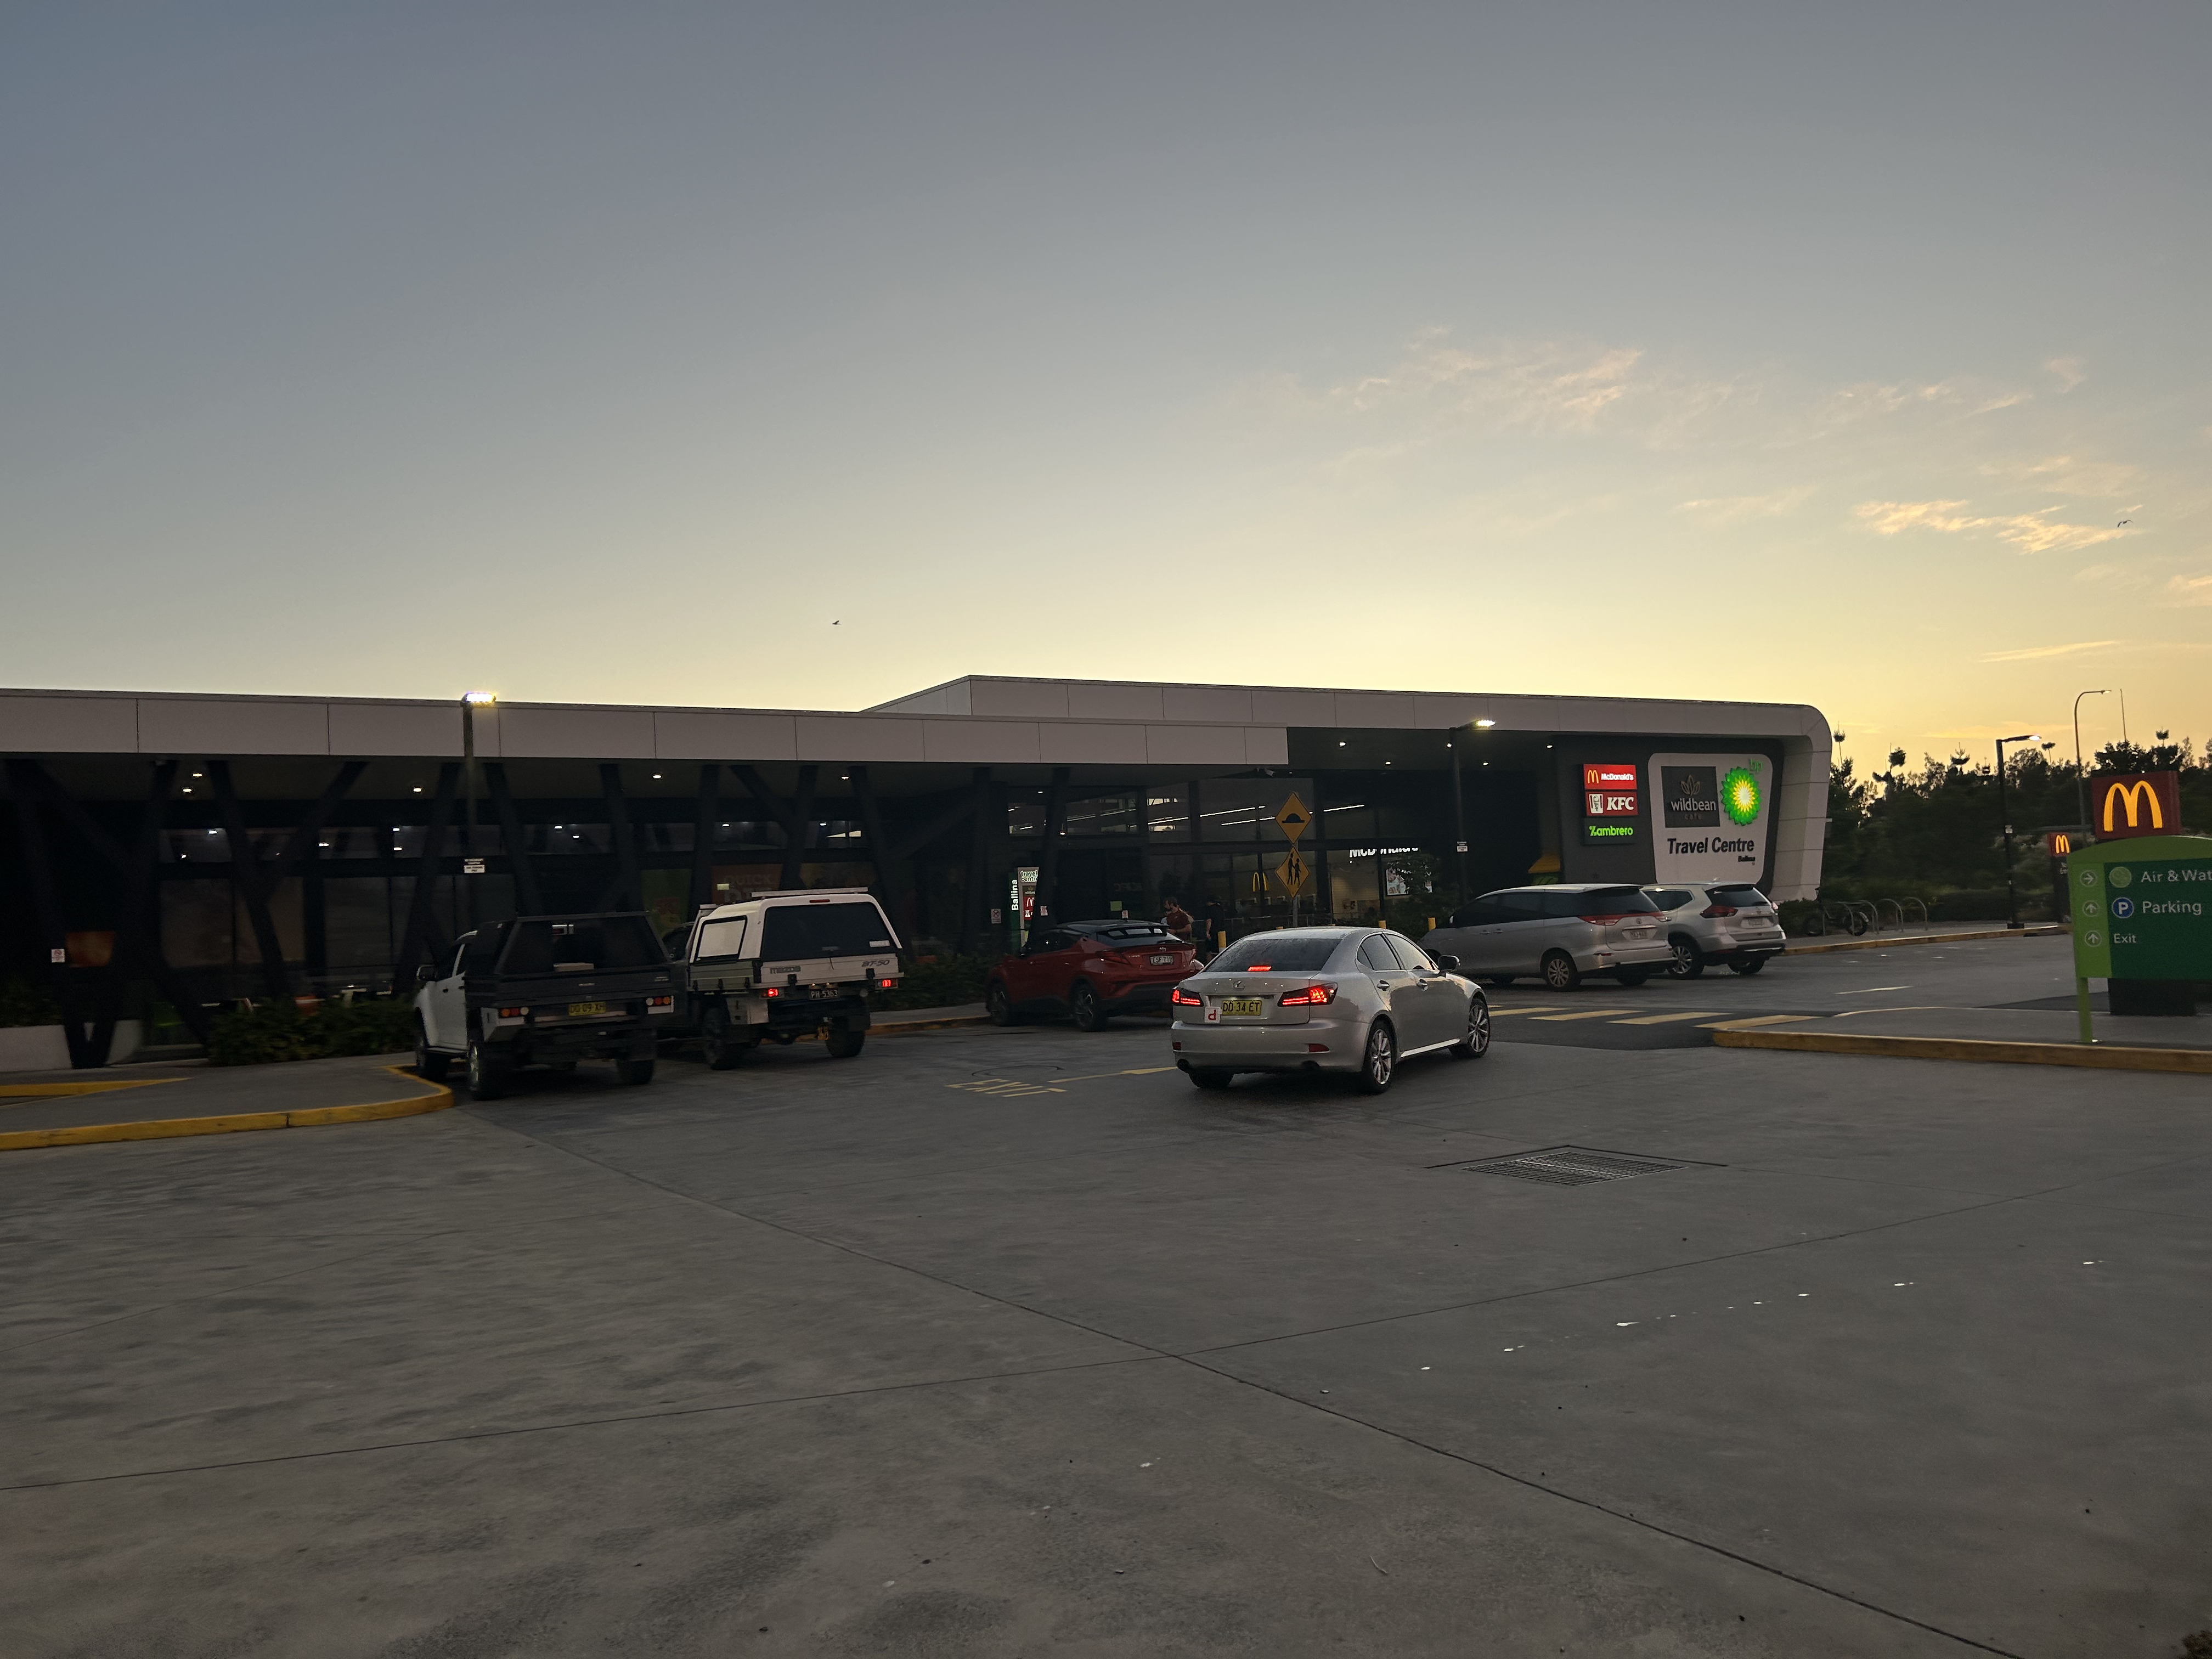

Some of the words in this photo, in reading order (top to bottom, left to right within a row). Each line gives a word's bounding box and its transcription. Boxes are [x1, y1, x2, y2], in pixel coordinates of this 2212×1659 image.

[1606, 797, 1634, 810] KFC
[1671, 798, 1717, 811] wildbean
[1589, 825, 1634, 837] Zambrero
[1667, 837, 1708, 854] Travel
[1712, 837, 1754, 853] Centre
[2141, 871, 2163, 883] Air
[2168, 870, 2180, 882] &
[1011, 879, 1019, 911] Ballina
[2142, 900, 2202, 916] Parking
[2114, 933, 2136, 944] Exit
[1249, 1001, 1260, 1012] ET
